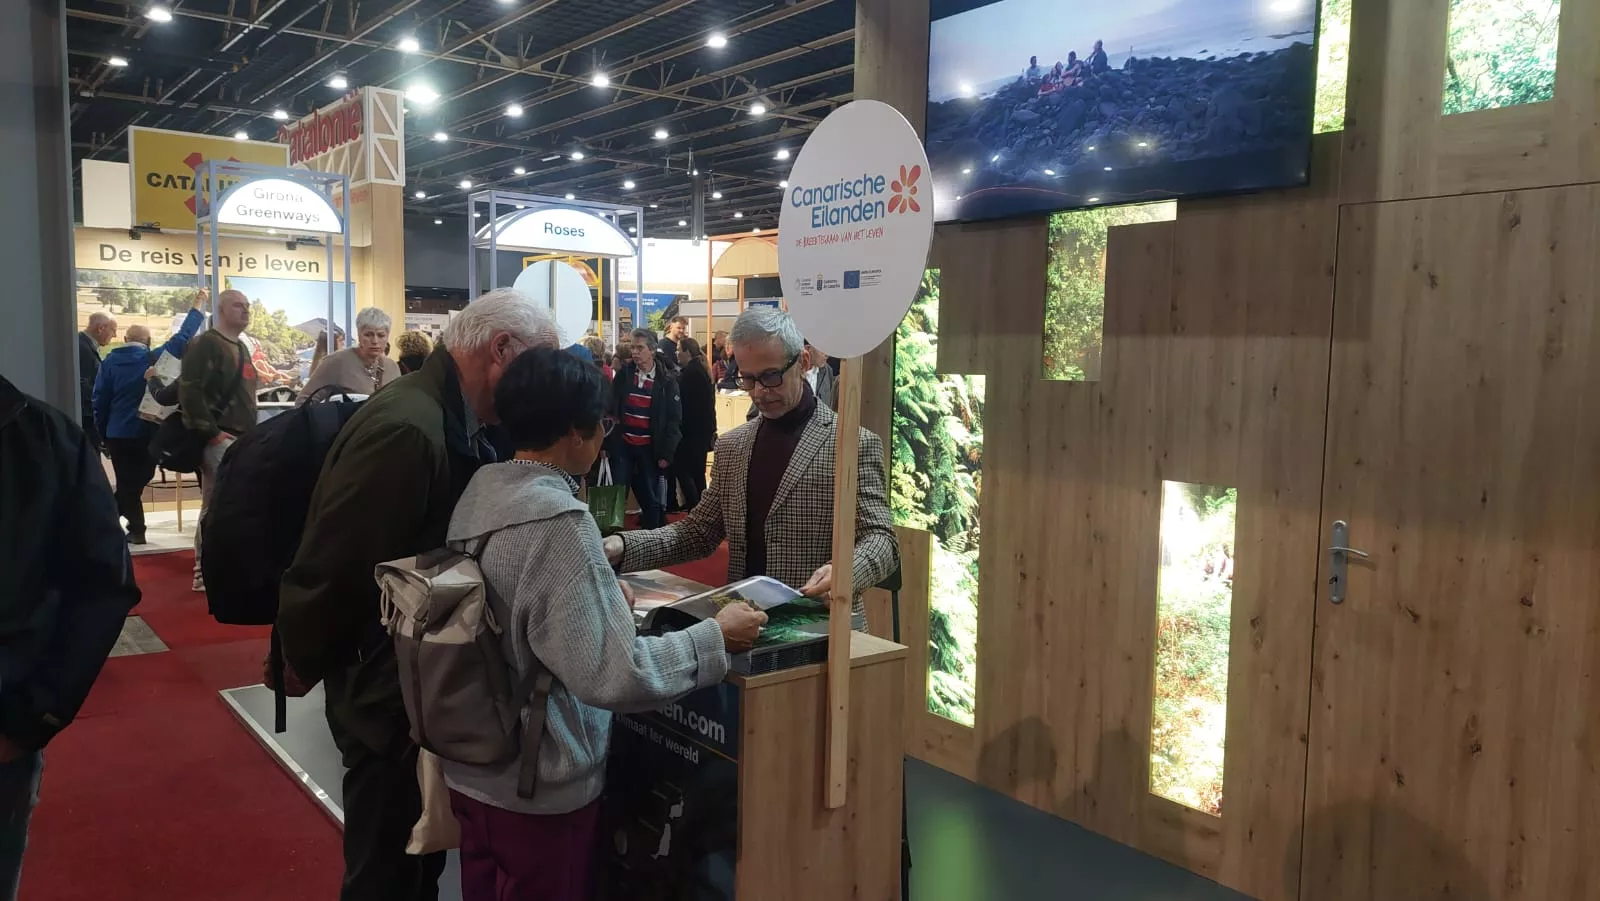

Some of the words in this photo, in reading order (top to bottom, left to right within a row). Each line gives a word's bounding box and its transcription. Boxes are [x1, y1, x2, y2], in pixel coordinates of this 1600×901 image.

[253, 187, 304, 203] Girona
[791, 173, 886, 208] Canarische
[236, 204, 320, 224] Greenways
[811, 199, 885, 229] Eilanden
[544, 222, 585, 238] Roses
[841, 231, 852, 244] VAN
[853, 228, 865, 240] HET
[865, 226, 884, 240] LEVEN
[99, 243, 132, 262] De
[140, 247, 184, 265] reis
[191, 252, 231, 268] van
[238, 252, 257, 273] je
[264, 253, 320, 273] leven
[657, 703, 725, 744] en.com
[665, 736, 699, 765] wereld
